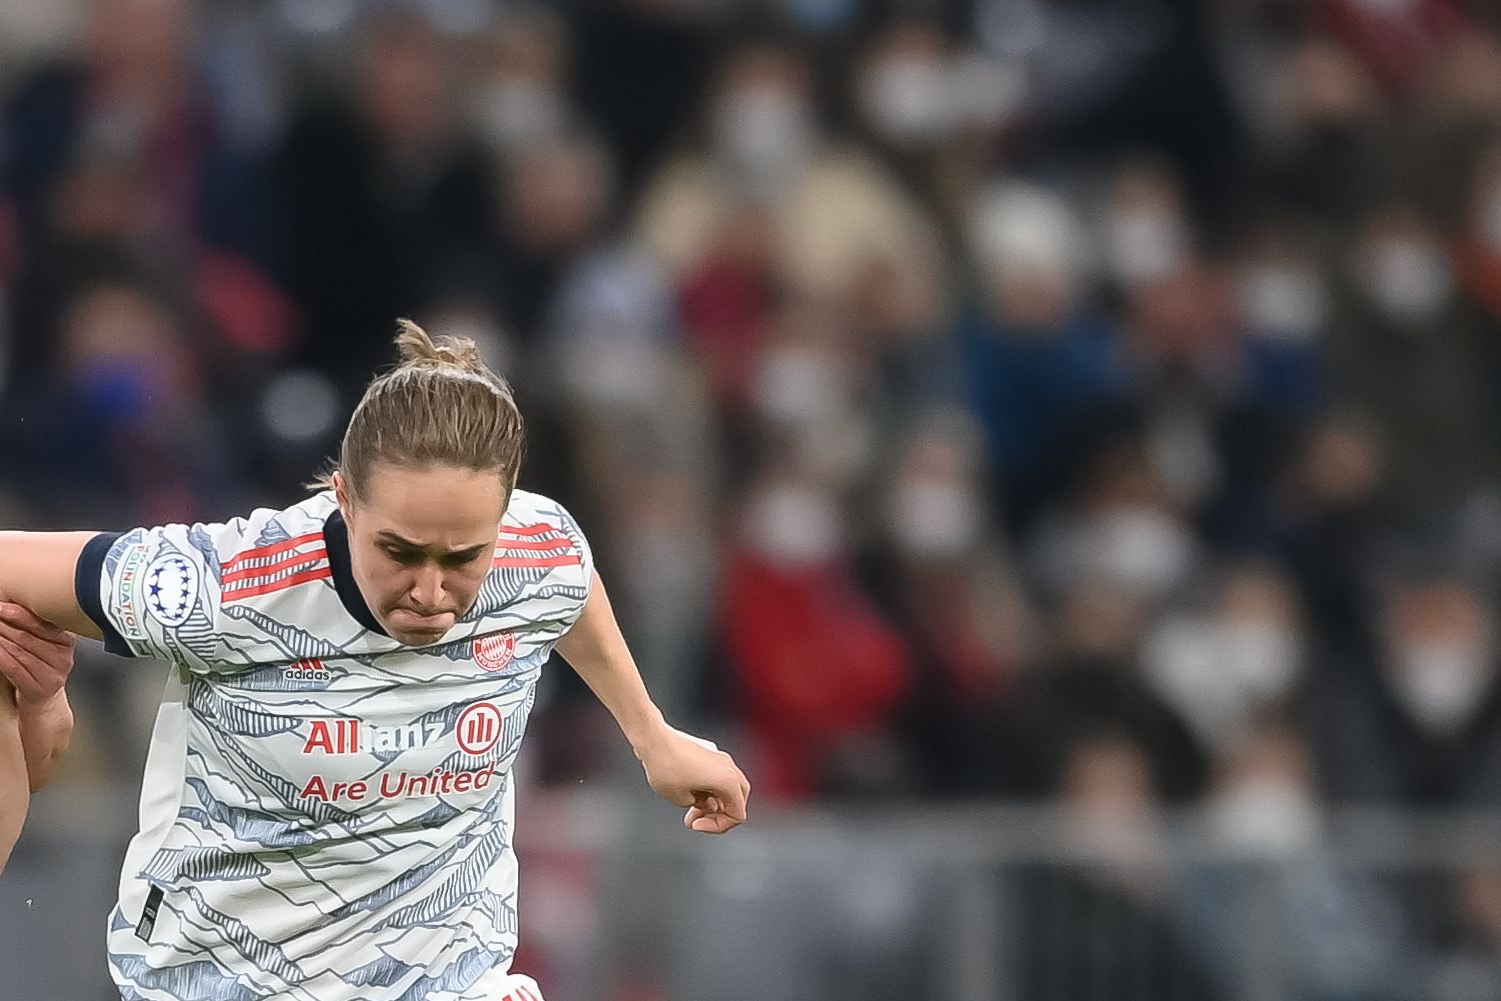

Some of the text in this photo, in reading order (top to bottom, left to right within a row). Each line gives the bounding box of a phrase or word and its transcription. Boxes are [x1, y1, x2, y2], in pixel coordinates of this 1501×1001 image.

[285, 668, 330, 680] adidas
[303, 719, 447, 755] Allianz
[300, 761, 498, 801] Are United
